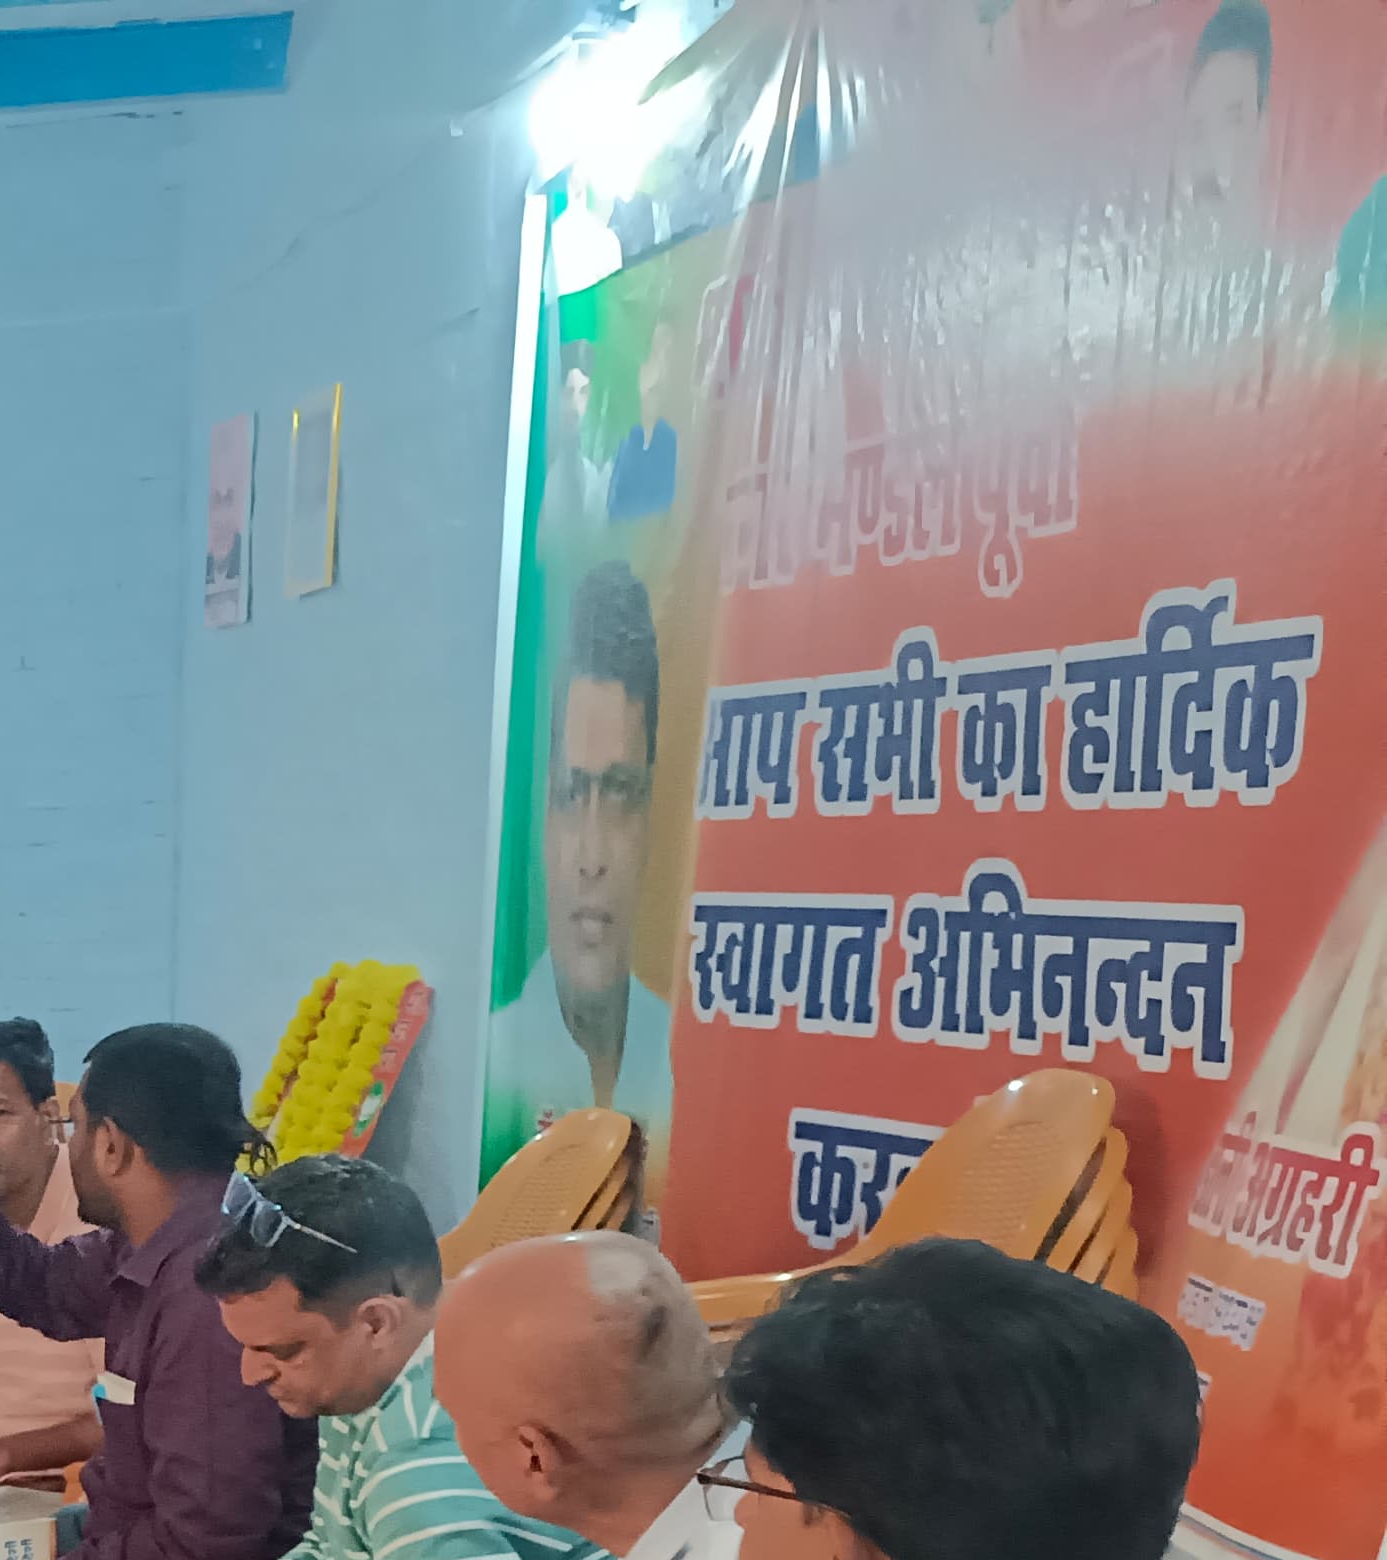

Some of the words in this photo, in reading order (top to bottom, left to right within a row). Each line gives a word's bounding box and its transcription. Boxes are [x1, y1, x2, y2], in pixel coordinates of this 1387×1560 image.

[817, 639, 948, 804] सभी
[956, 663, 1052, 799] का
[1064, 594, 1316, 797] हार्दिक
[691, 904, 888, 1025] स्वागत
[899, 870, 1237, 1065] अभिनन्दन
[794, 1119, 935, 1238] कर
